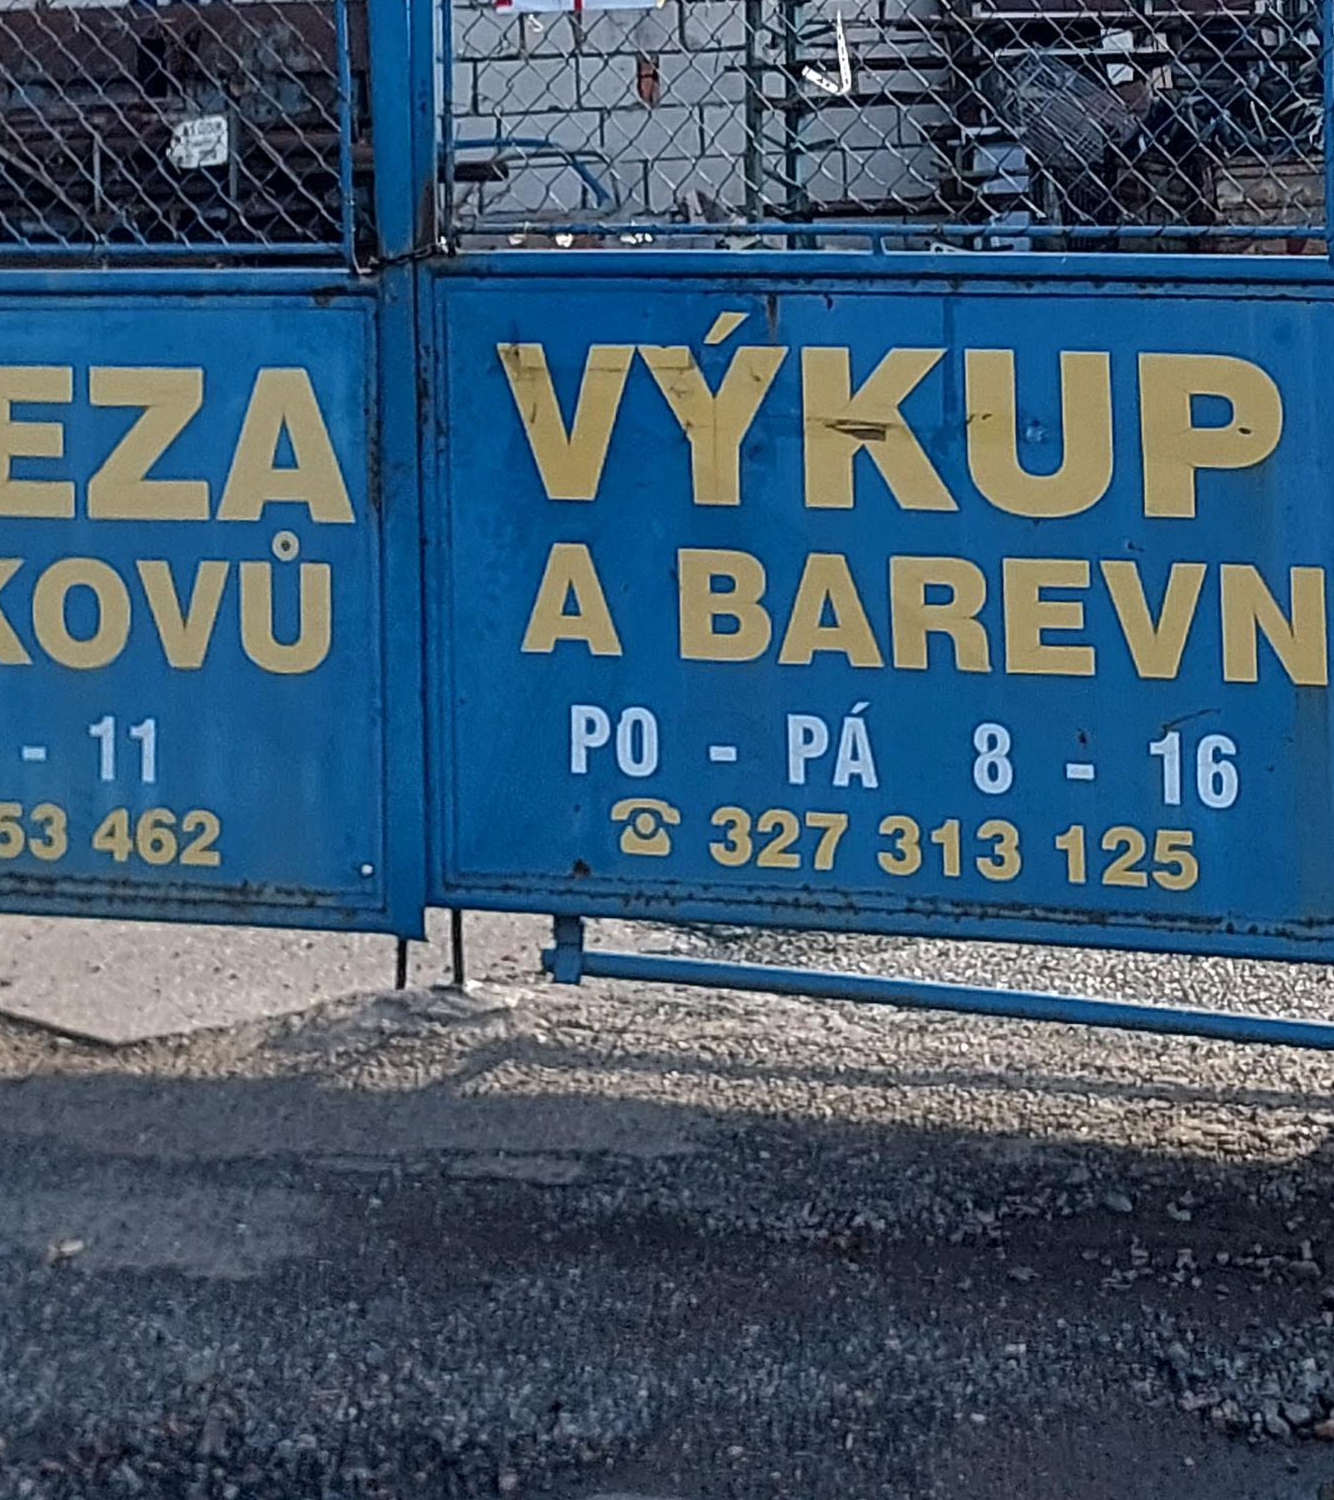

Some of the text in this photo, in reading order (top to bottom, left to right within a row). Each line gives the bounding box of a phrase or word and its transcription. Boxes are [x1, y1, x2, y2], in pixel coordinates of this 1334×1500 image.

[497, 312, 1284, 518] VÝKUP
[522, 542, 1328, 686] A BAREVN
[89, 715, 157, 783] 11
[570, 704, 658, 778] PO
[788, 703, 878, 789] PÁ
[973, 724, 1013, 795] 8
[1149, 731, 1238, 808] 16
[92, 808, 221, 865] 462
[709, 808, 1198, 890] 327 313 125
